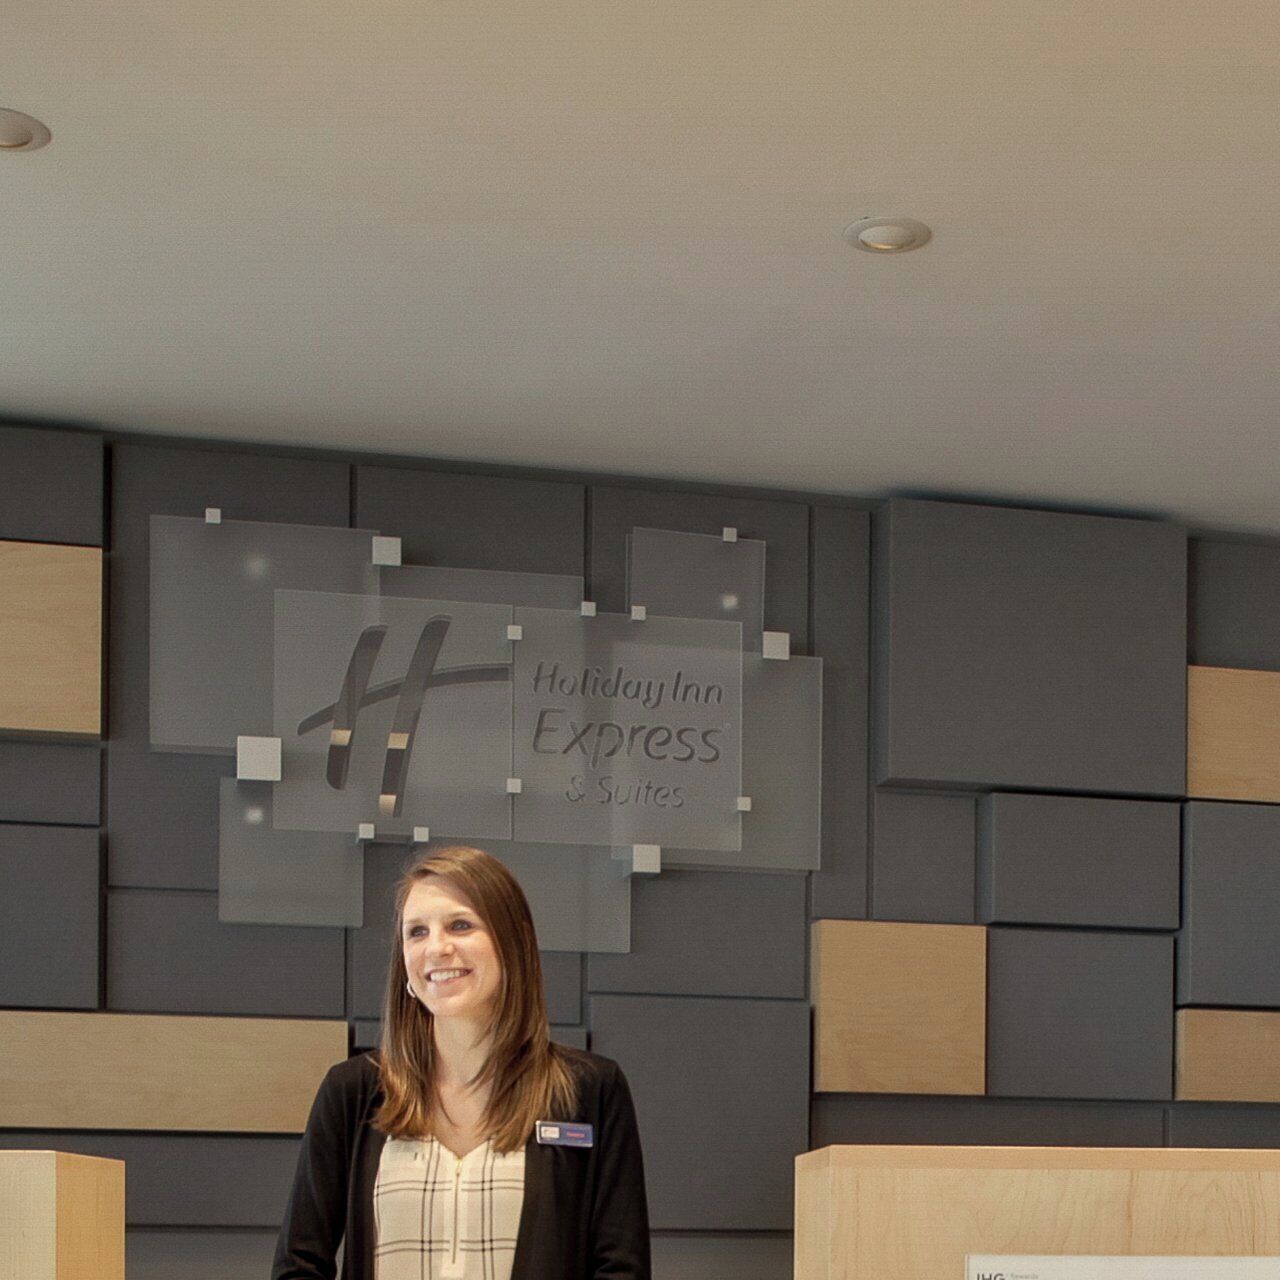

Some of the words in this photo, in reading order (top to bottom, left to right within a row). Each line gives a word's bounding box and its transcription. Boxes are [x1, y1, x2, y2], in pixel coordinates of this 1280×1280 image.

[532, 662, 666, 710] Holiday
[672, 670, 723, 705] Inn
[532, 708, 722, 769] Express
[565, 774, 586, 803] &
[594, 774, 686, 809] Suites
